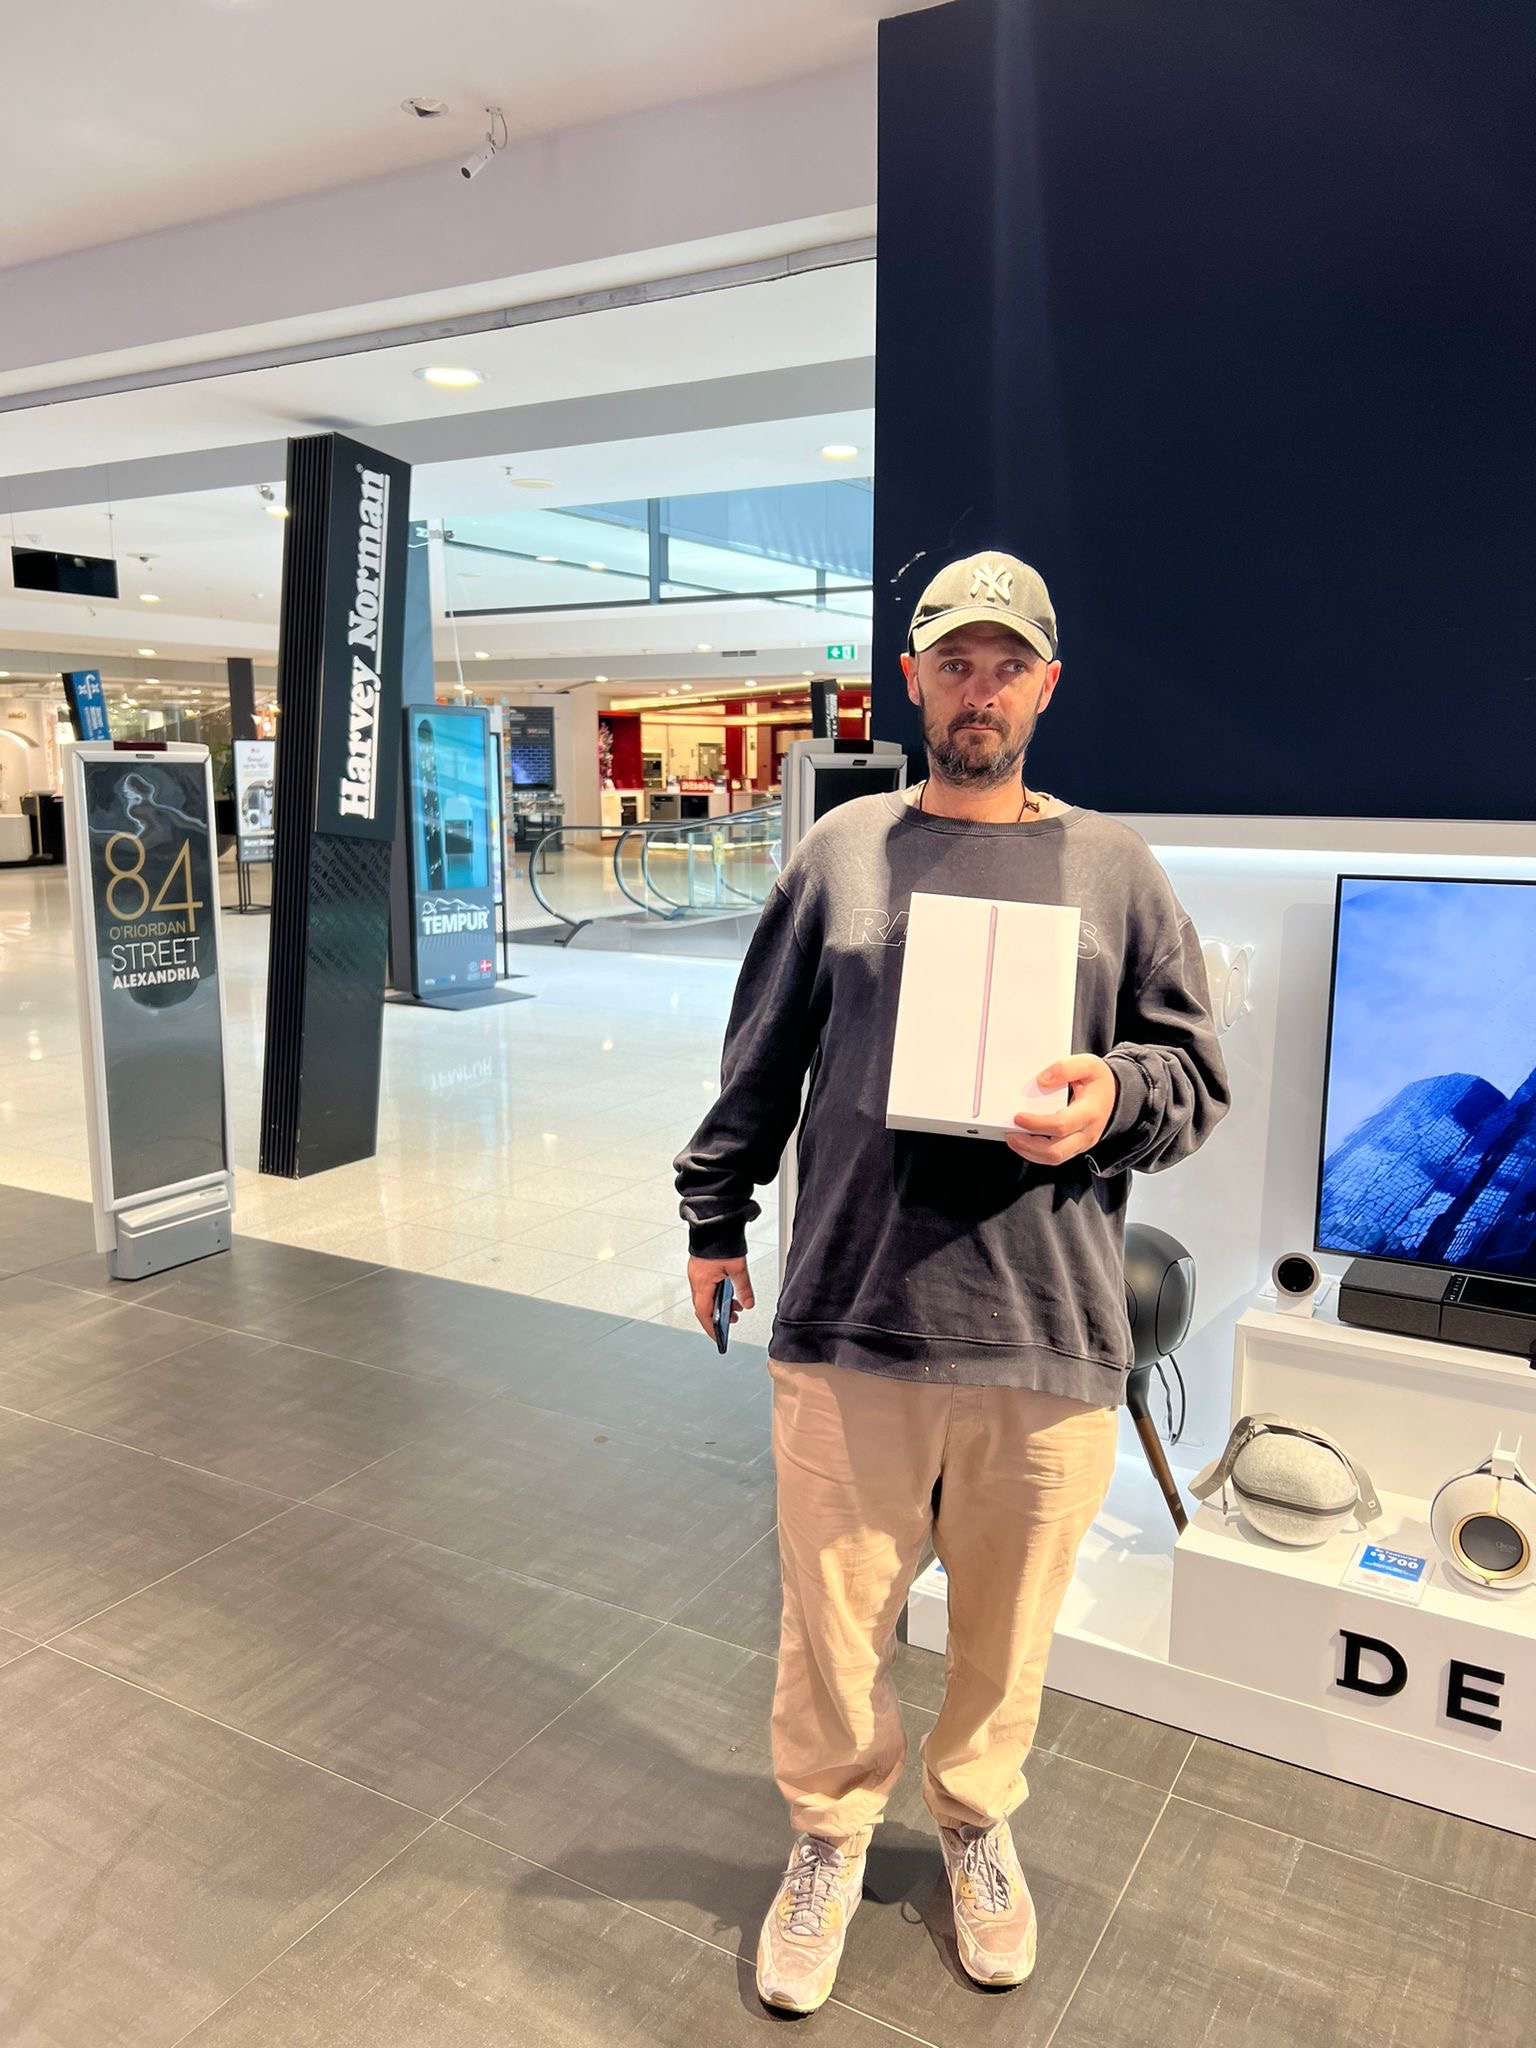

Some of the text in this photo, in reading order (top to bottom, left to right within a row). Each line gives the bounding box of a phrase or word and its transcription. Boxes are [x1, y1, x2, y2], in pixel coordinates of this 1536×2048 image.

[339, 469, 385, 819] Harvey Norman
[105, 832, 203, 933] 84
[110, 921, 187, 941] O'RIORDAN
[422, 910, 489, 936] TEMPUR
[111, 936, 201, 973] STREET
[112, 965, 201, 991] ALEXANDRIA
[1335, 1628, 1506, 1732] DE
